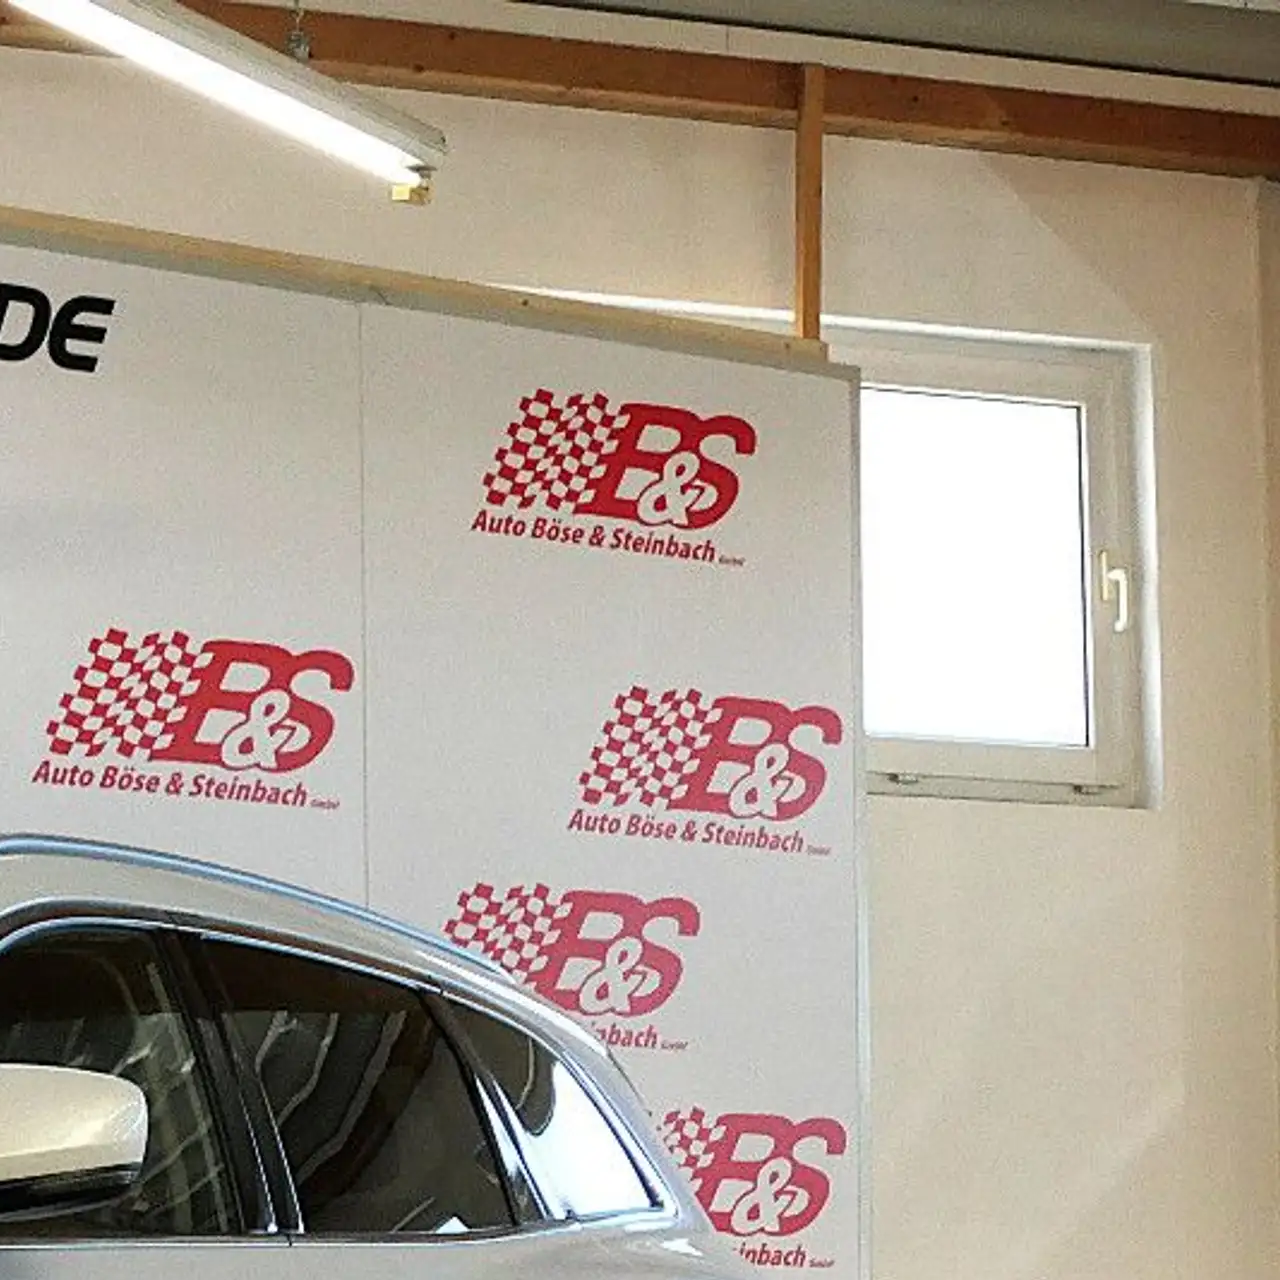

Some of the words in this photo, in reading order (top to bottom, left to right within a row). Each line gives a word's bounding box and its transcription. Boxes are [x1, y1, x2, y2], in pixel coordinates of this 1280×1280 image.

[574, 401, 758, 531] B&S
[472, 510, 525, 536] Auto
[531, 518, 584, 543] Böse
[589, 526, 605, 547] &
[610, 528, 714, 562] Steinbach
[152, 639, 356, 774] B&S
[32, 761, 94, 786] Auto
[100, 766, 160, 792] Böse
[165, 773, 184, 795] &
[189, 775, 306, 806] Steinbach
[668, 695, 843, 822] B&S
[568, 809, 620, 833] Auto
[626, 815, 677, 839] Böse
[680, 821, 697, 841] &
[702, 822, 803, 852] Steinbach
